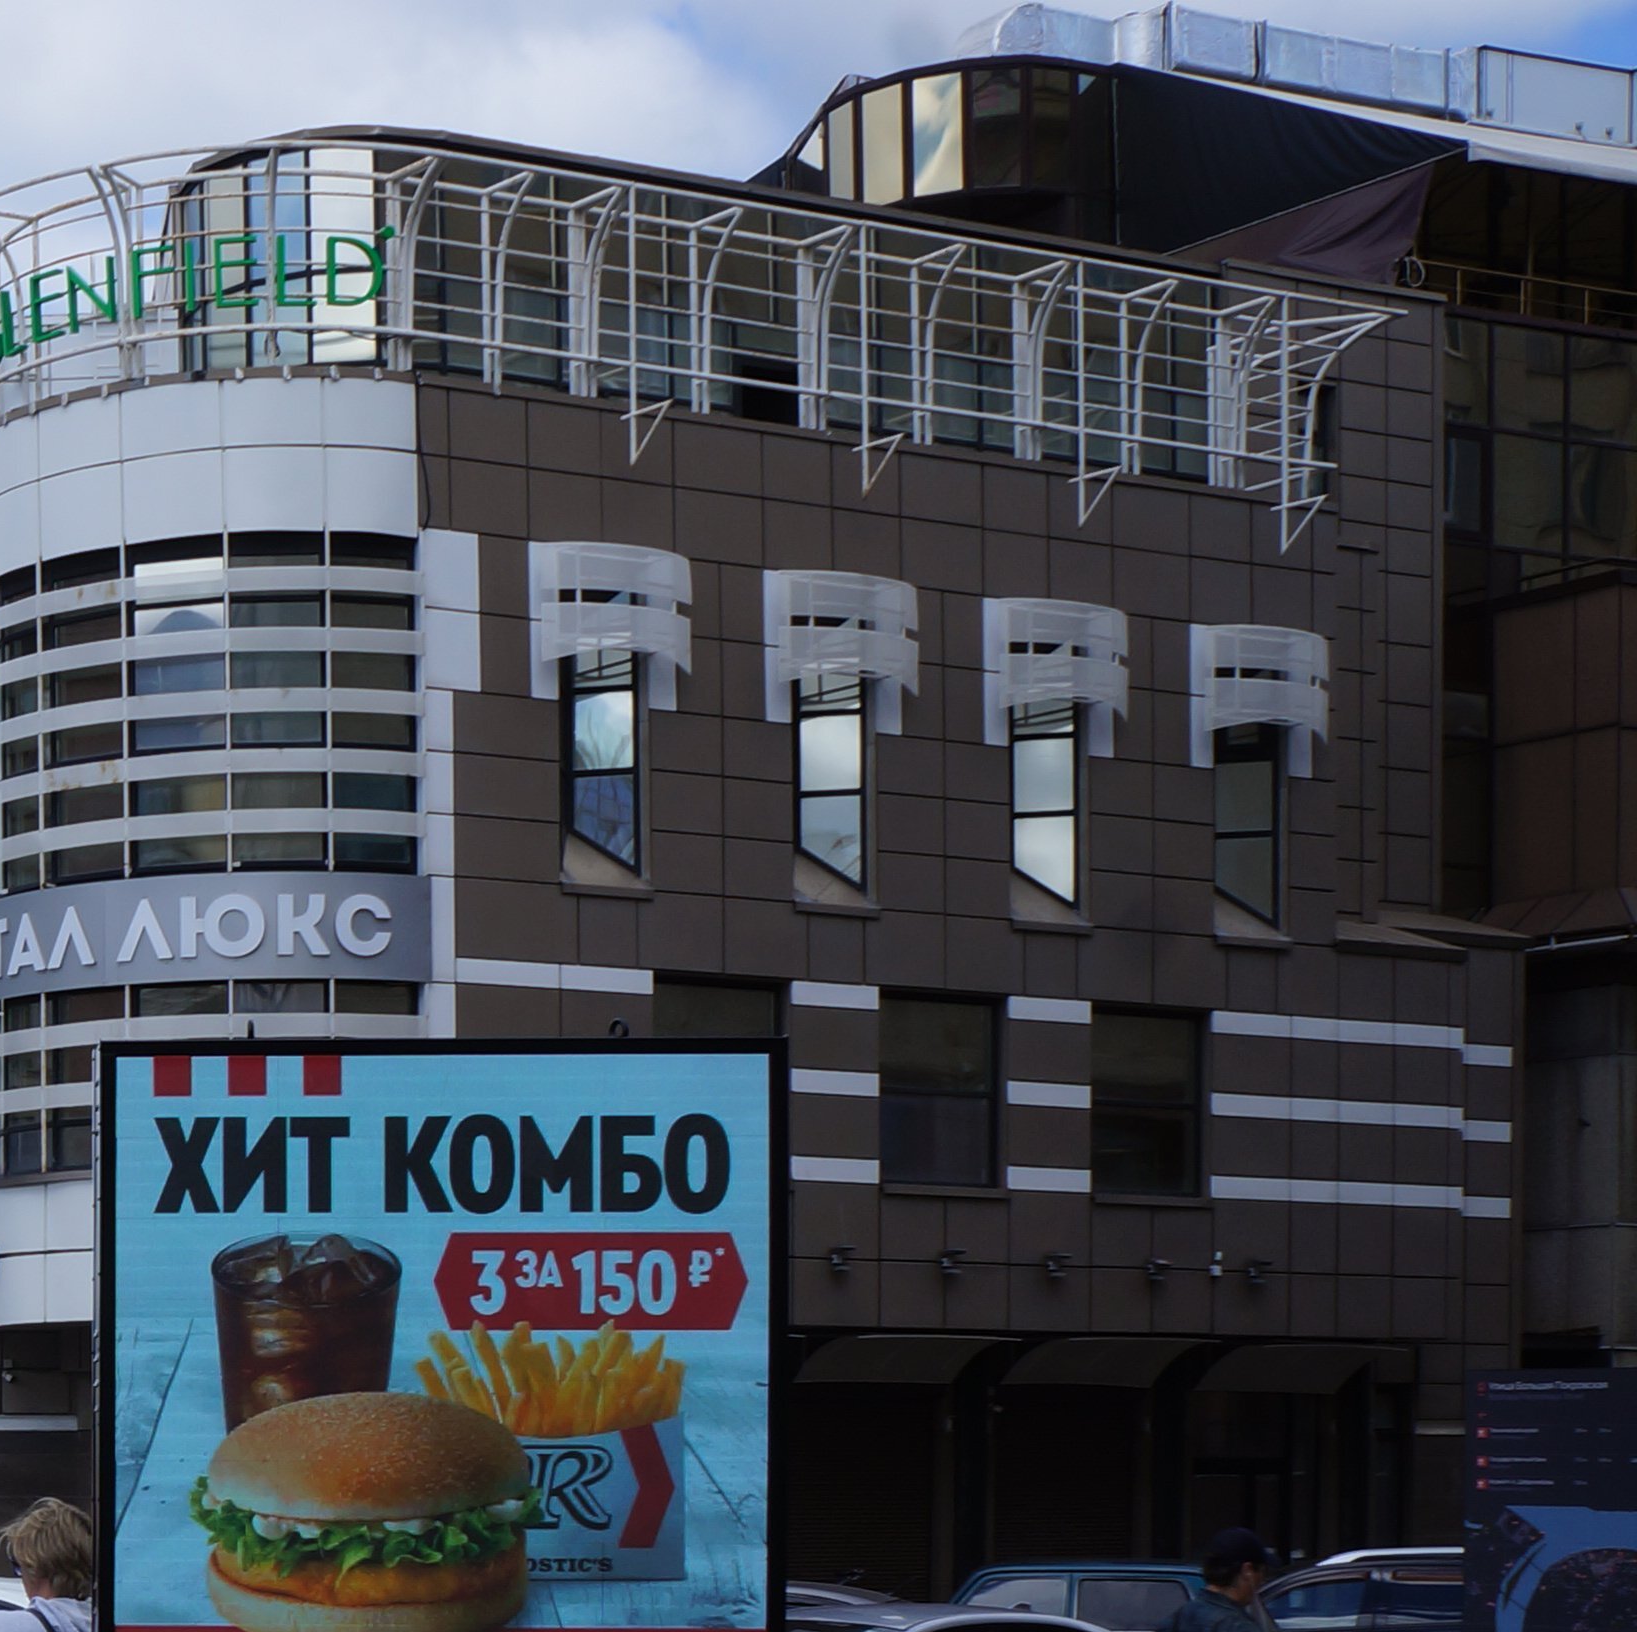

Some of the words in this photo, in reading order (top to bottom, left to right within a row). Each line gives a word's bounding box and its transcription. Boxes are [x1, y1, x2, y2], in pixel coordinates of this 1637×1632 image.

[116, 893, 392, 963] ЛЮКС
[153, 1115, 350, 1213] ХИТ
[383, 1113, 730, 1215] КОМБО
[470, 1250, 507, 1315] 3
[514, 1250, 564, 1288] ЗА
